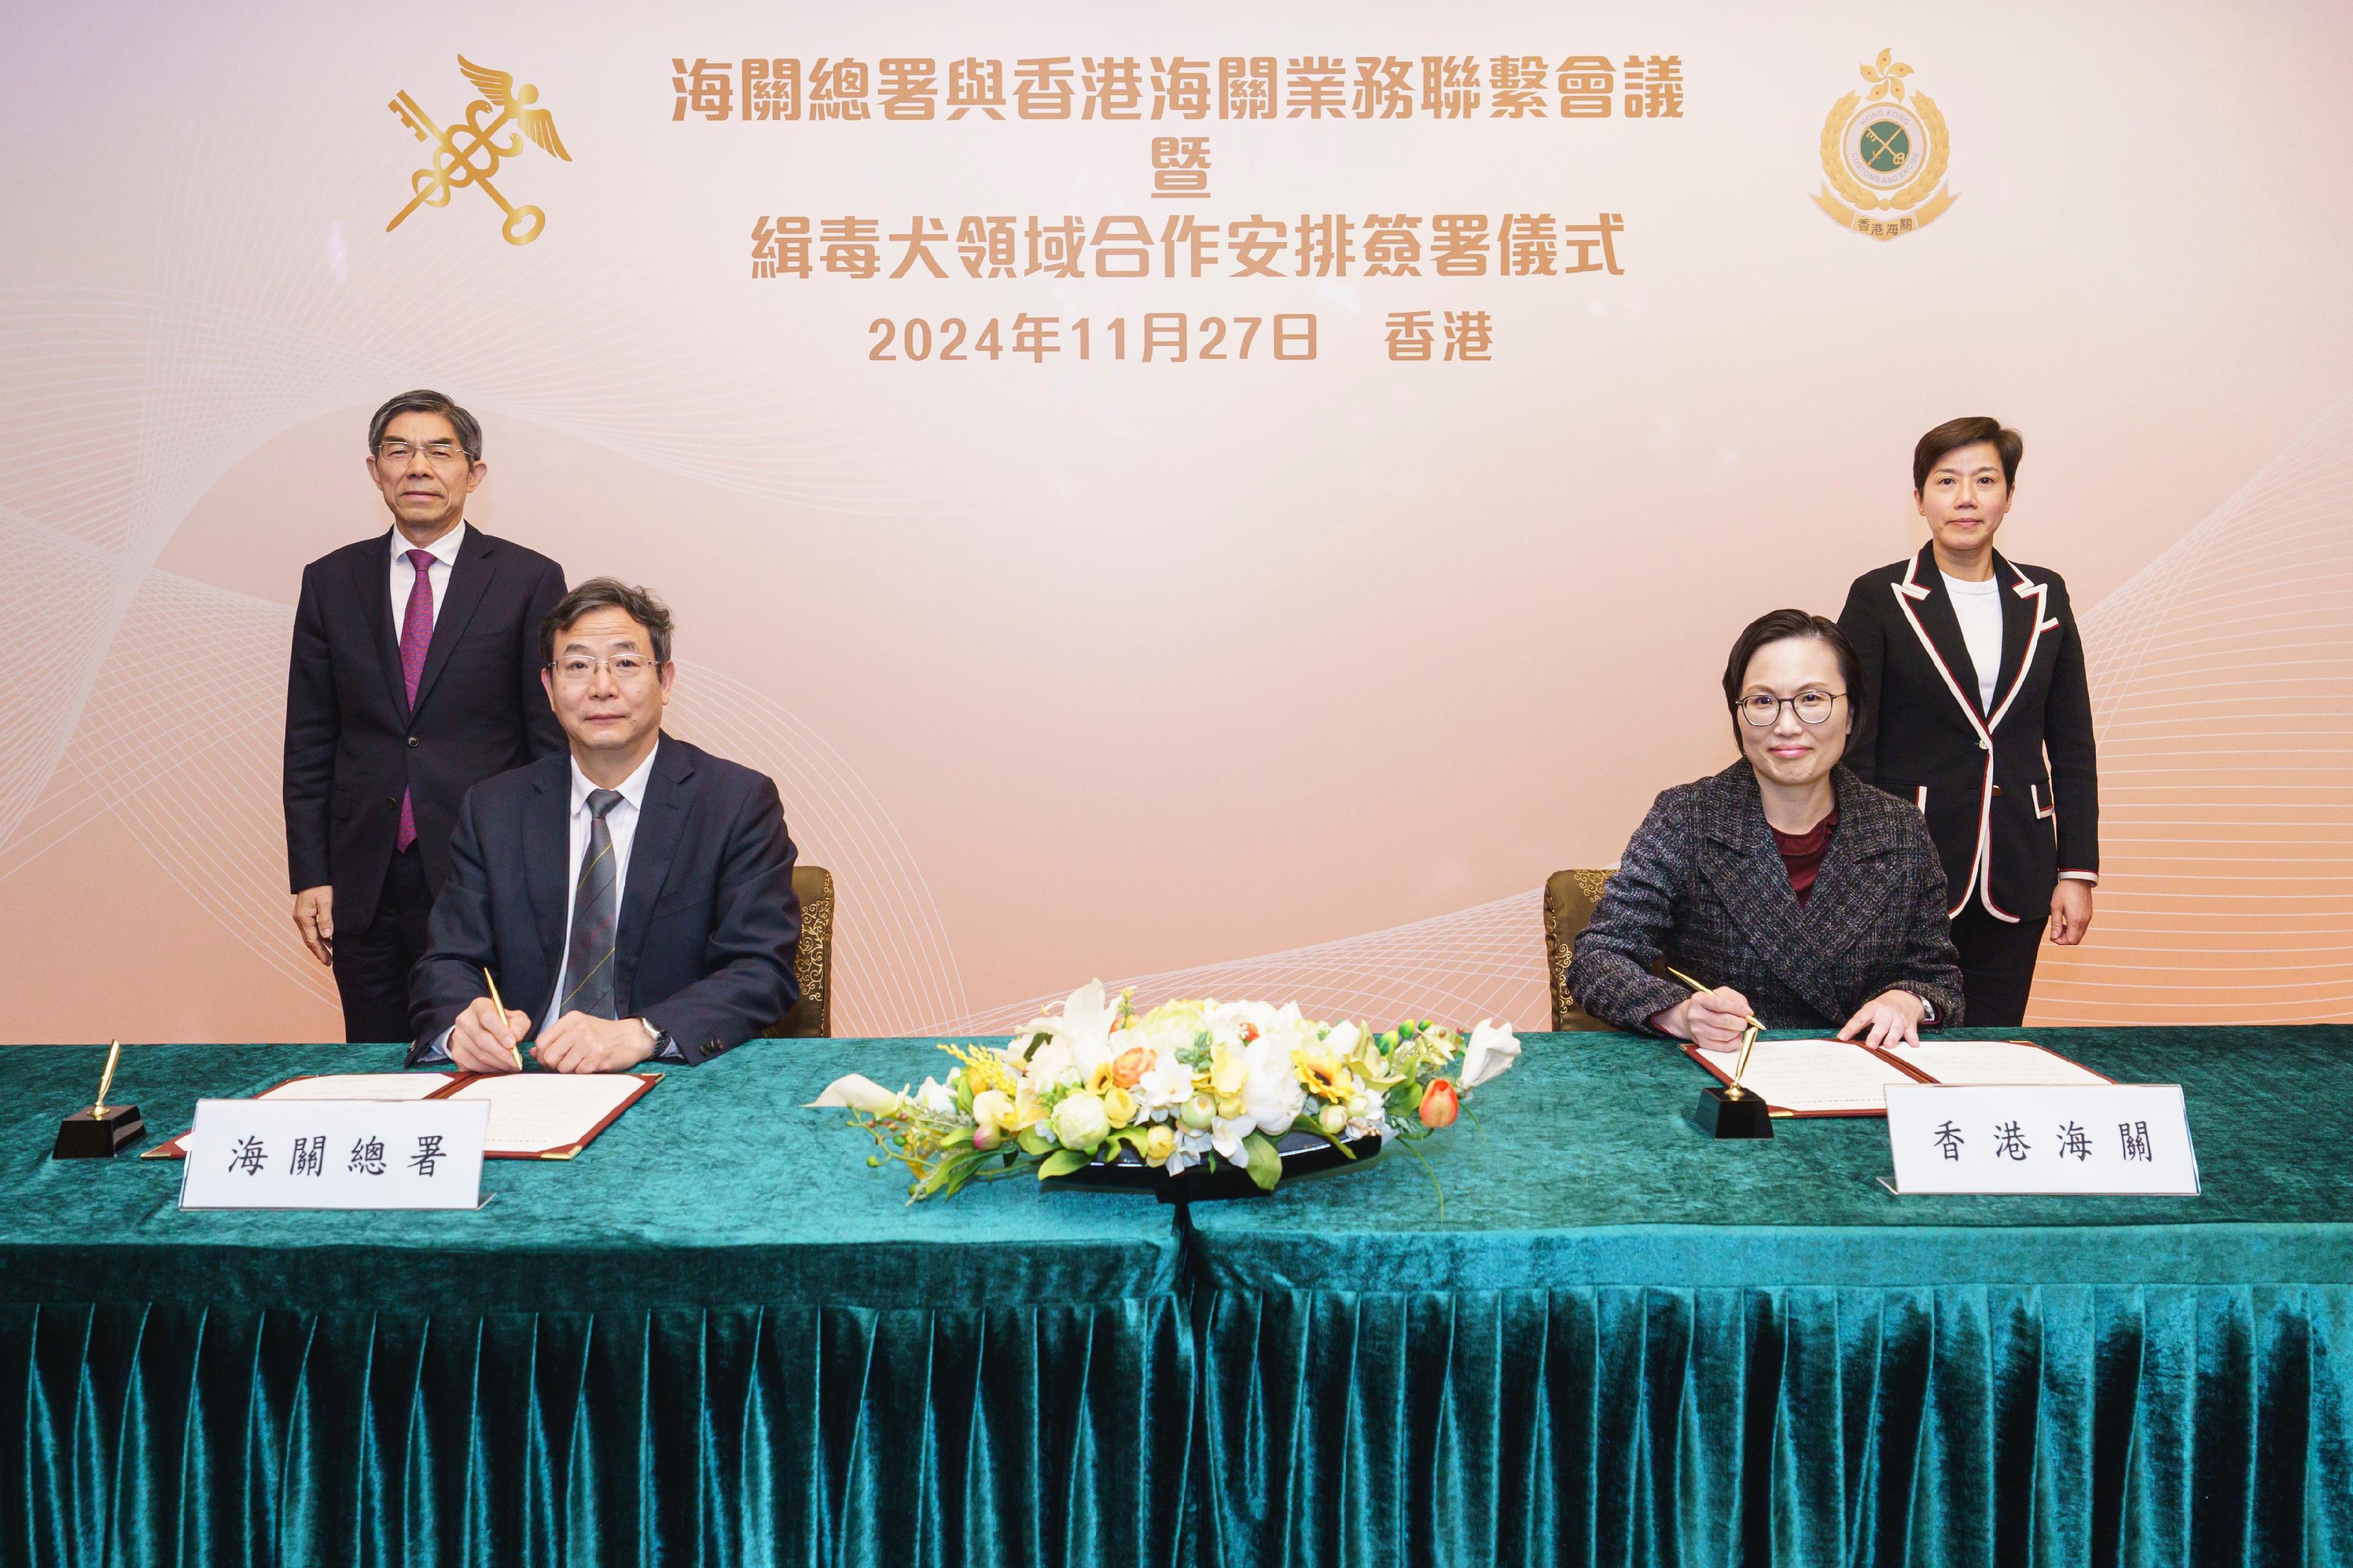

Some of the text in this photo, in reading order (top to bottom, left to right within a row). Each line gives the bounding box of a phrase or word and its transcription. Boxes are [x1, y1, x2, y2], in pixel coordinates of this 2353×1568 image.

[672, 56, 1684, 122] 海關總署與香港海關業務聯繫會議
[1861, 109, 1909, 125] HONG KONG
[1151, 137, 1211, 199] 暨
[1852, 152, 1919, 184] CUSTOMS AND EXCISE
[751, 213, 1625, 279] 緝毒犬領域合作安排簽署儀式
[1858, 218, 1912, 235] 香港海關
[869, 310, 1493, 363] 2024年11月27日 香港
[228, 1135, 447, 1177] 海關總署
[1934, 1120, 2152, 1162] 香港海關
